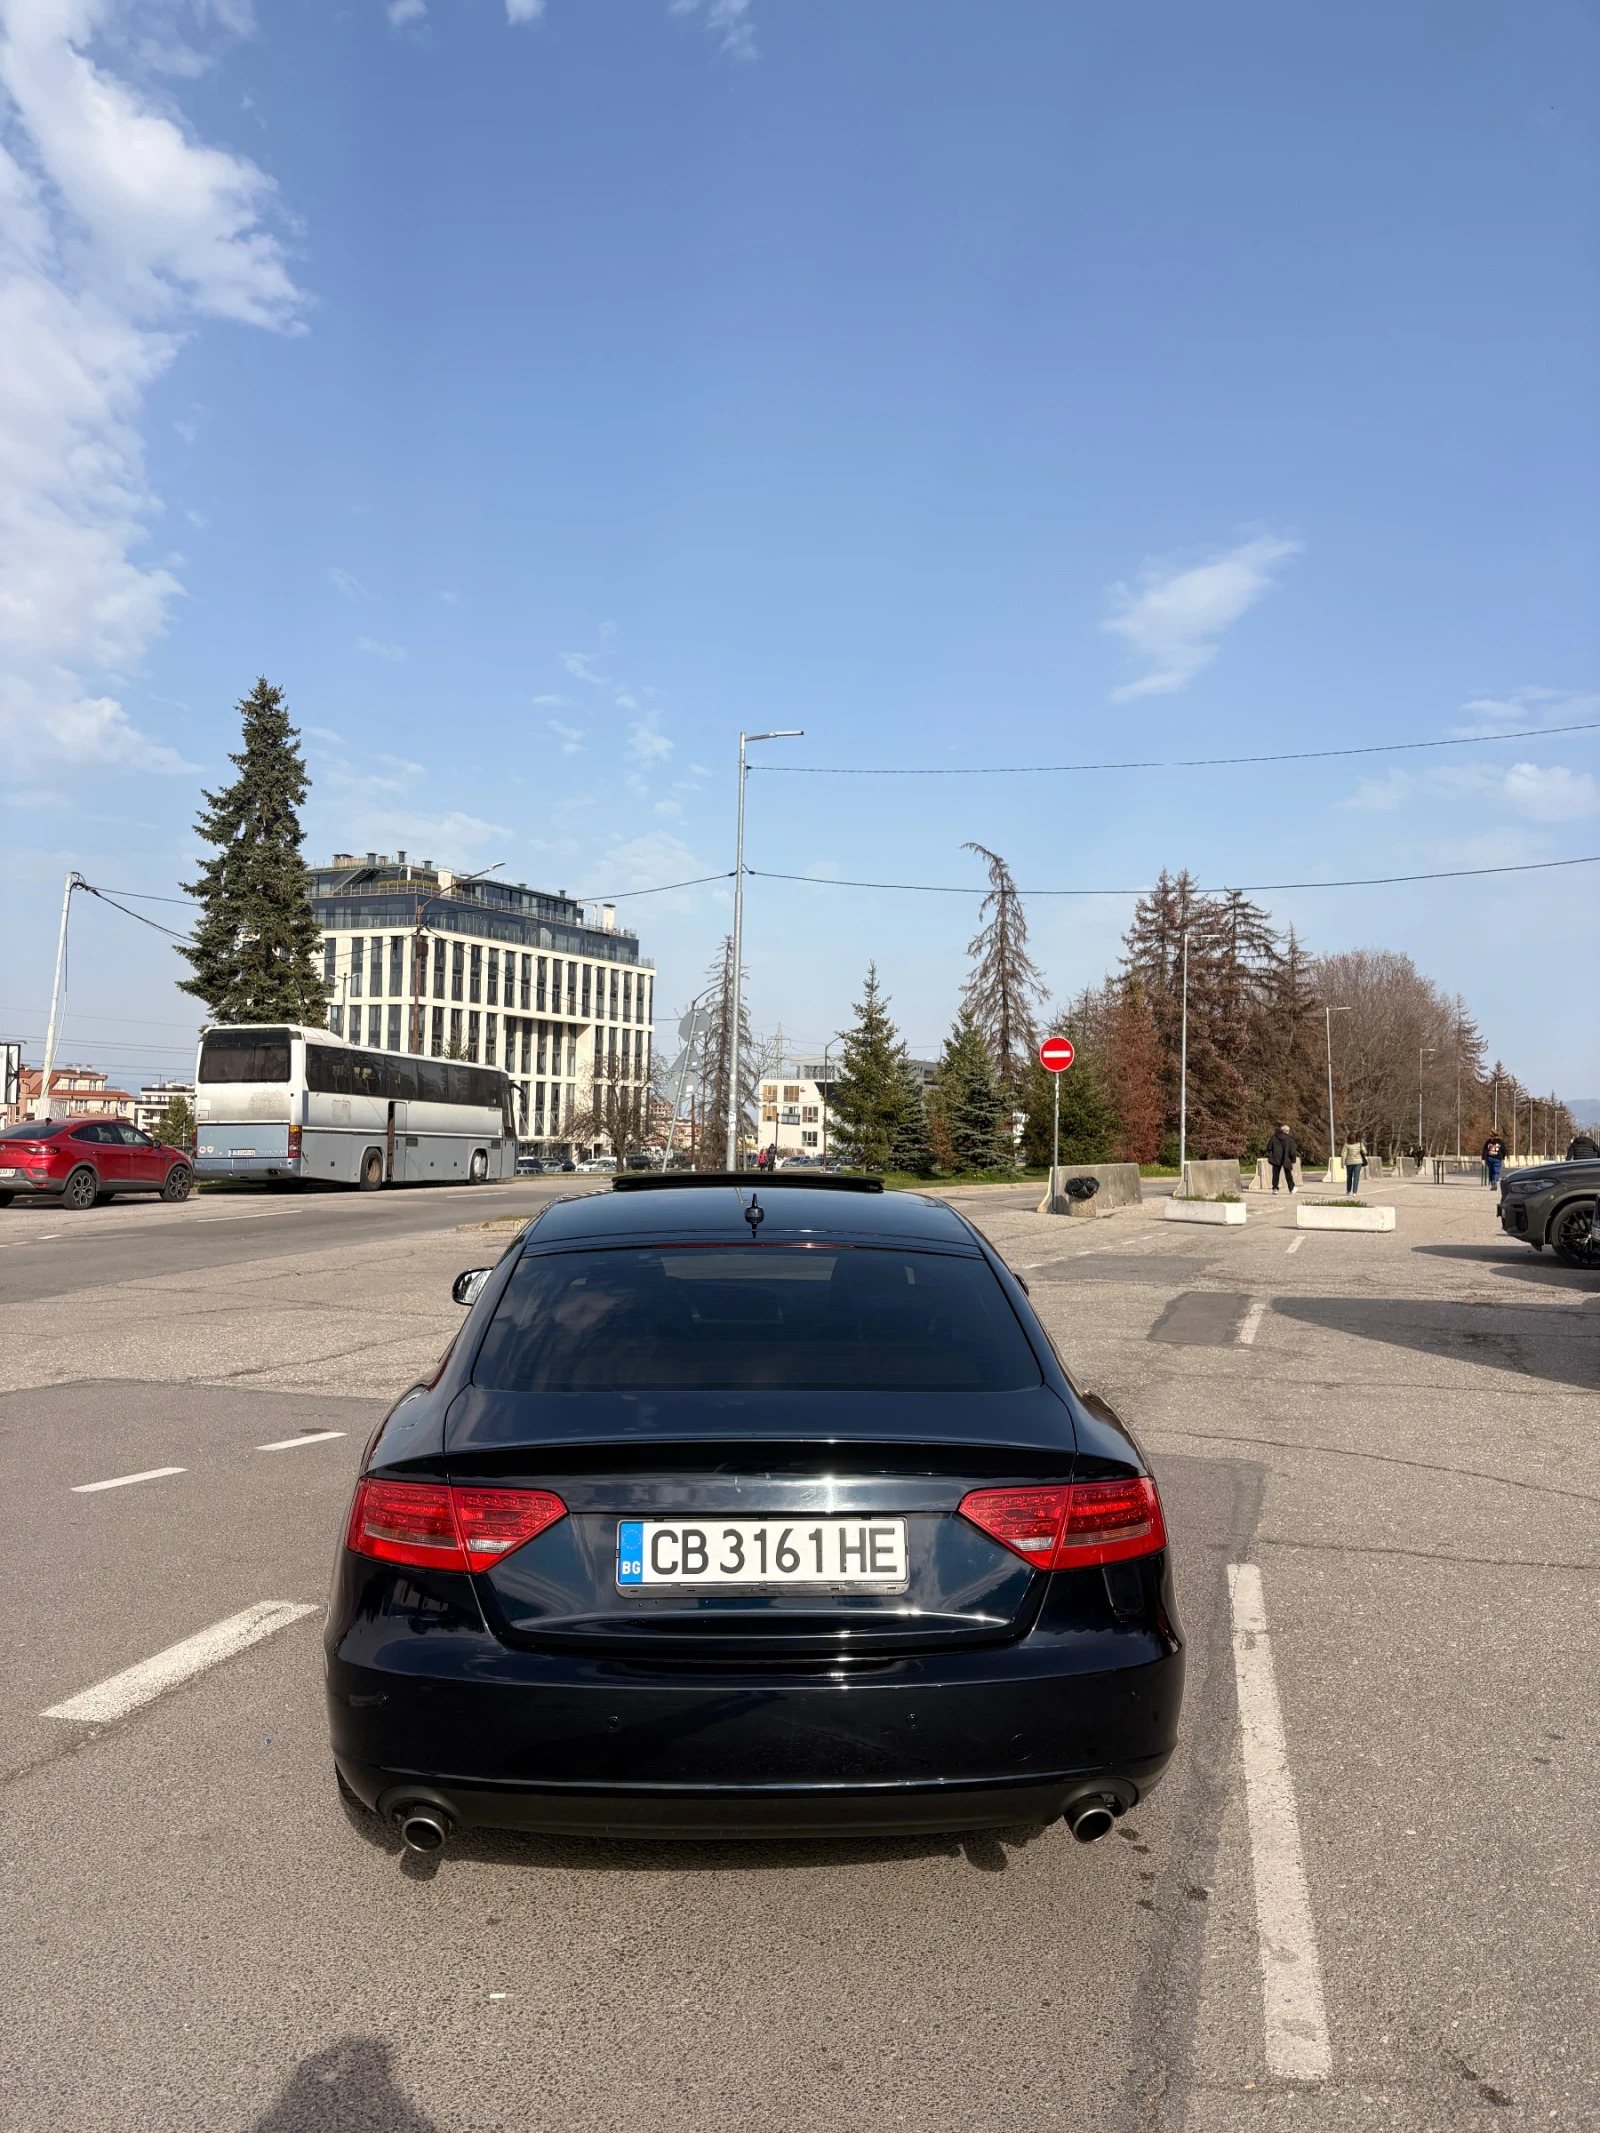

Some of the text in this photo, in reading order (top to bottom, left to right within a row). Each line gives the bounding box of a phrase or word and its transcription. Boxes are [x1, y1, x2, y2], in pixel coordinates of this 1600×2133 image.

[651, 1527, 898, 1575] CB 3161 HE
[621, 1560, 641, 1575] BG
